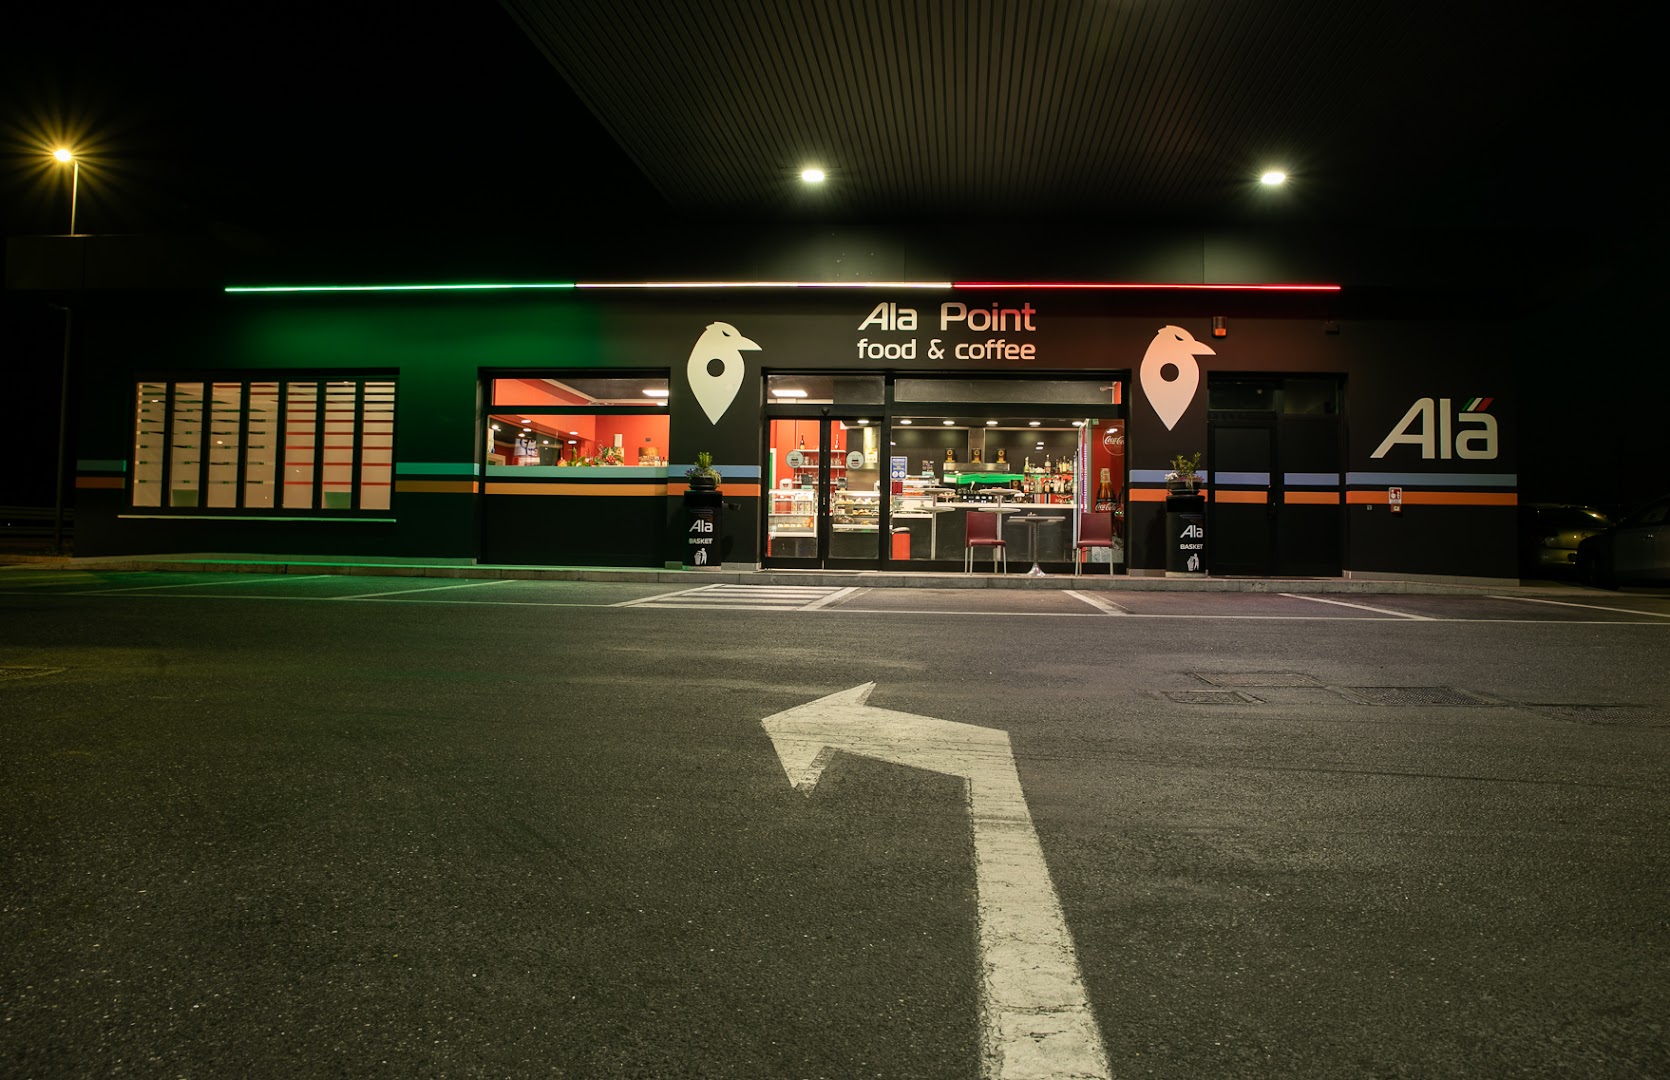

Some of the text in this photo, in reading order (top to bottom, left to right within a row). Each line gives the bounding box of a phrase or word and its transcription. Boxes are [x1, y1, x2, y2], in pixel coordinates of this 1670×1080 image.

[857, 302, 1037, 332] Ala Point
[857, 338, 1037, 360] food & coffee
[688, 519, 714, 533] Ala
[1179, 524, 1204, 539] Ala
[688, 537, 714, 545] BASKET
